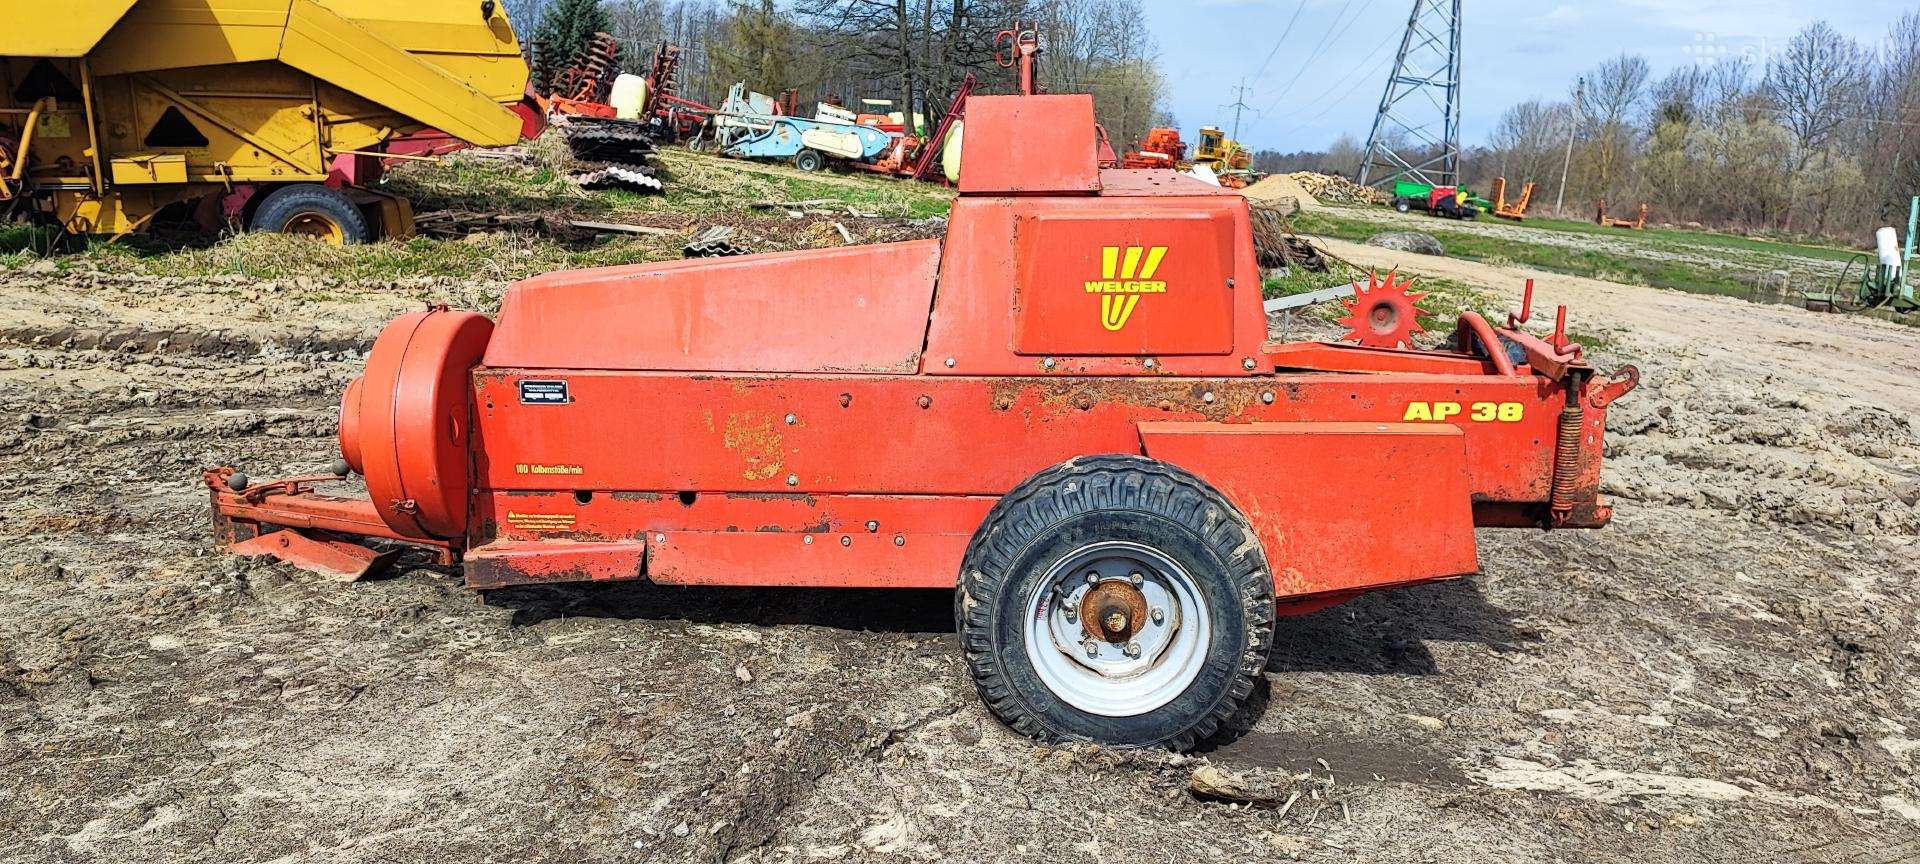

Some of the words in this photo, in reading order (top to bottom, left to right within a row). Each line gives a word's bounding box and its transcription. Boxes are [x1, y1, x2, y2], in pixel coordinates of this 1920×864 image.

[1084, 281, 1166, 293] WELGER
[1403, 401, 1462, 421] AP
[1470, 401, 1524, 422] 38
[515, 464, 529, 474] 100
